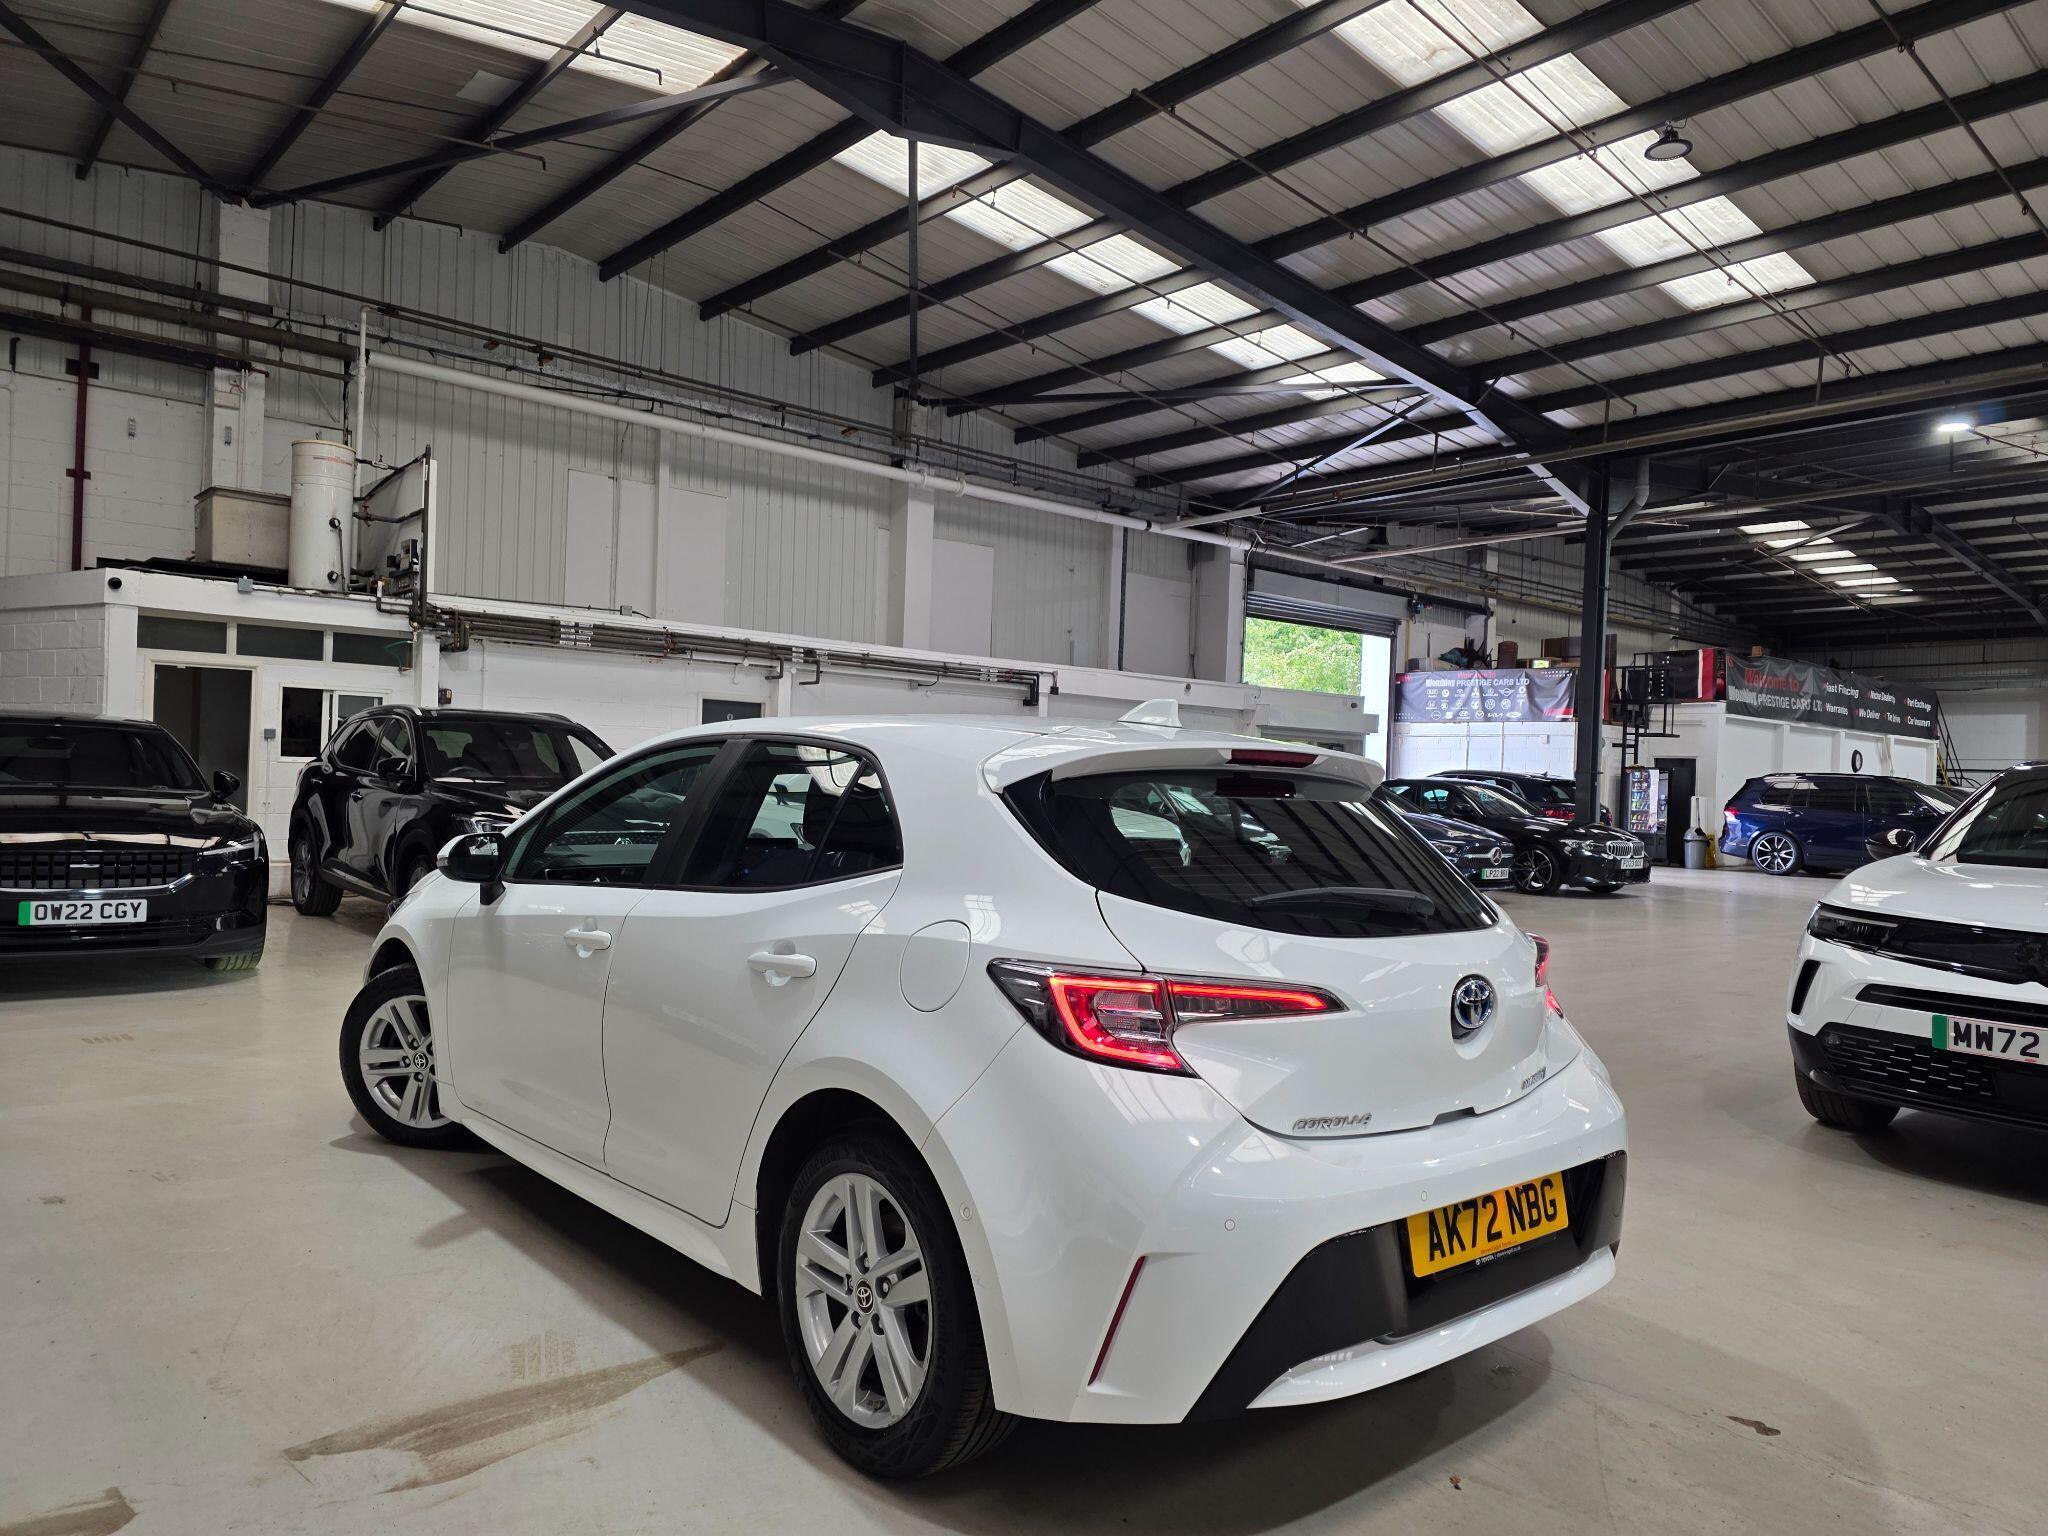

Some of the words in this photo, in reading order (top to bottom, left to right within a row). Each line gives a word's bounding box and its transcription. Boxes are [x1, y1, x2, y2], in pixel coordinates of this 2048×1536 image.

[1456, 679, 1492, 687] PRESTIGE
[1757, 693, 1790, 709] PRESTIGE
[34, 903, 94, 921] OW22
[99, 902, 142, 919] CGY
[1953, 1020, 2040, 1058] MW72
[1292, 1112, 1373, 1131] COROLLA
[1428, 1194, 1503, 1262] AK72
[1504, 1178, 1558, 1235] NBG
